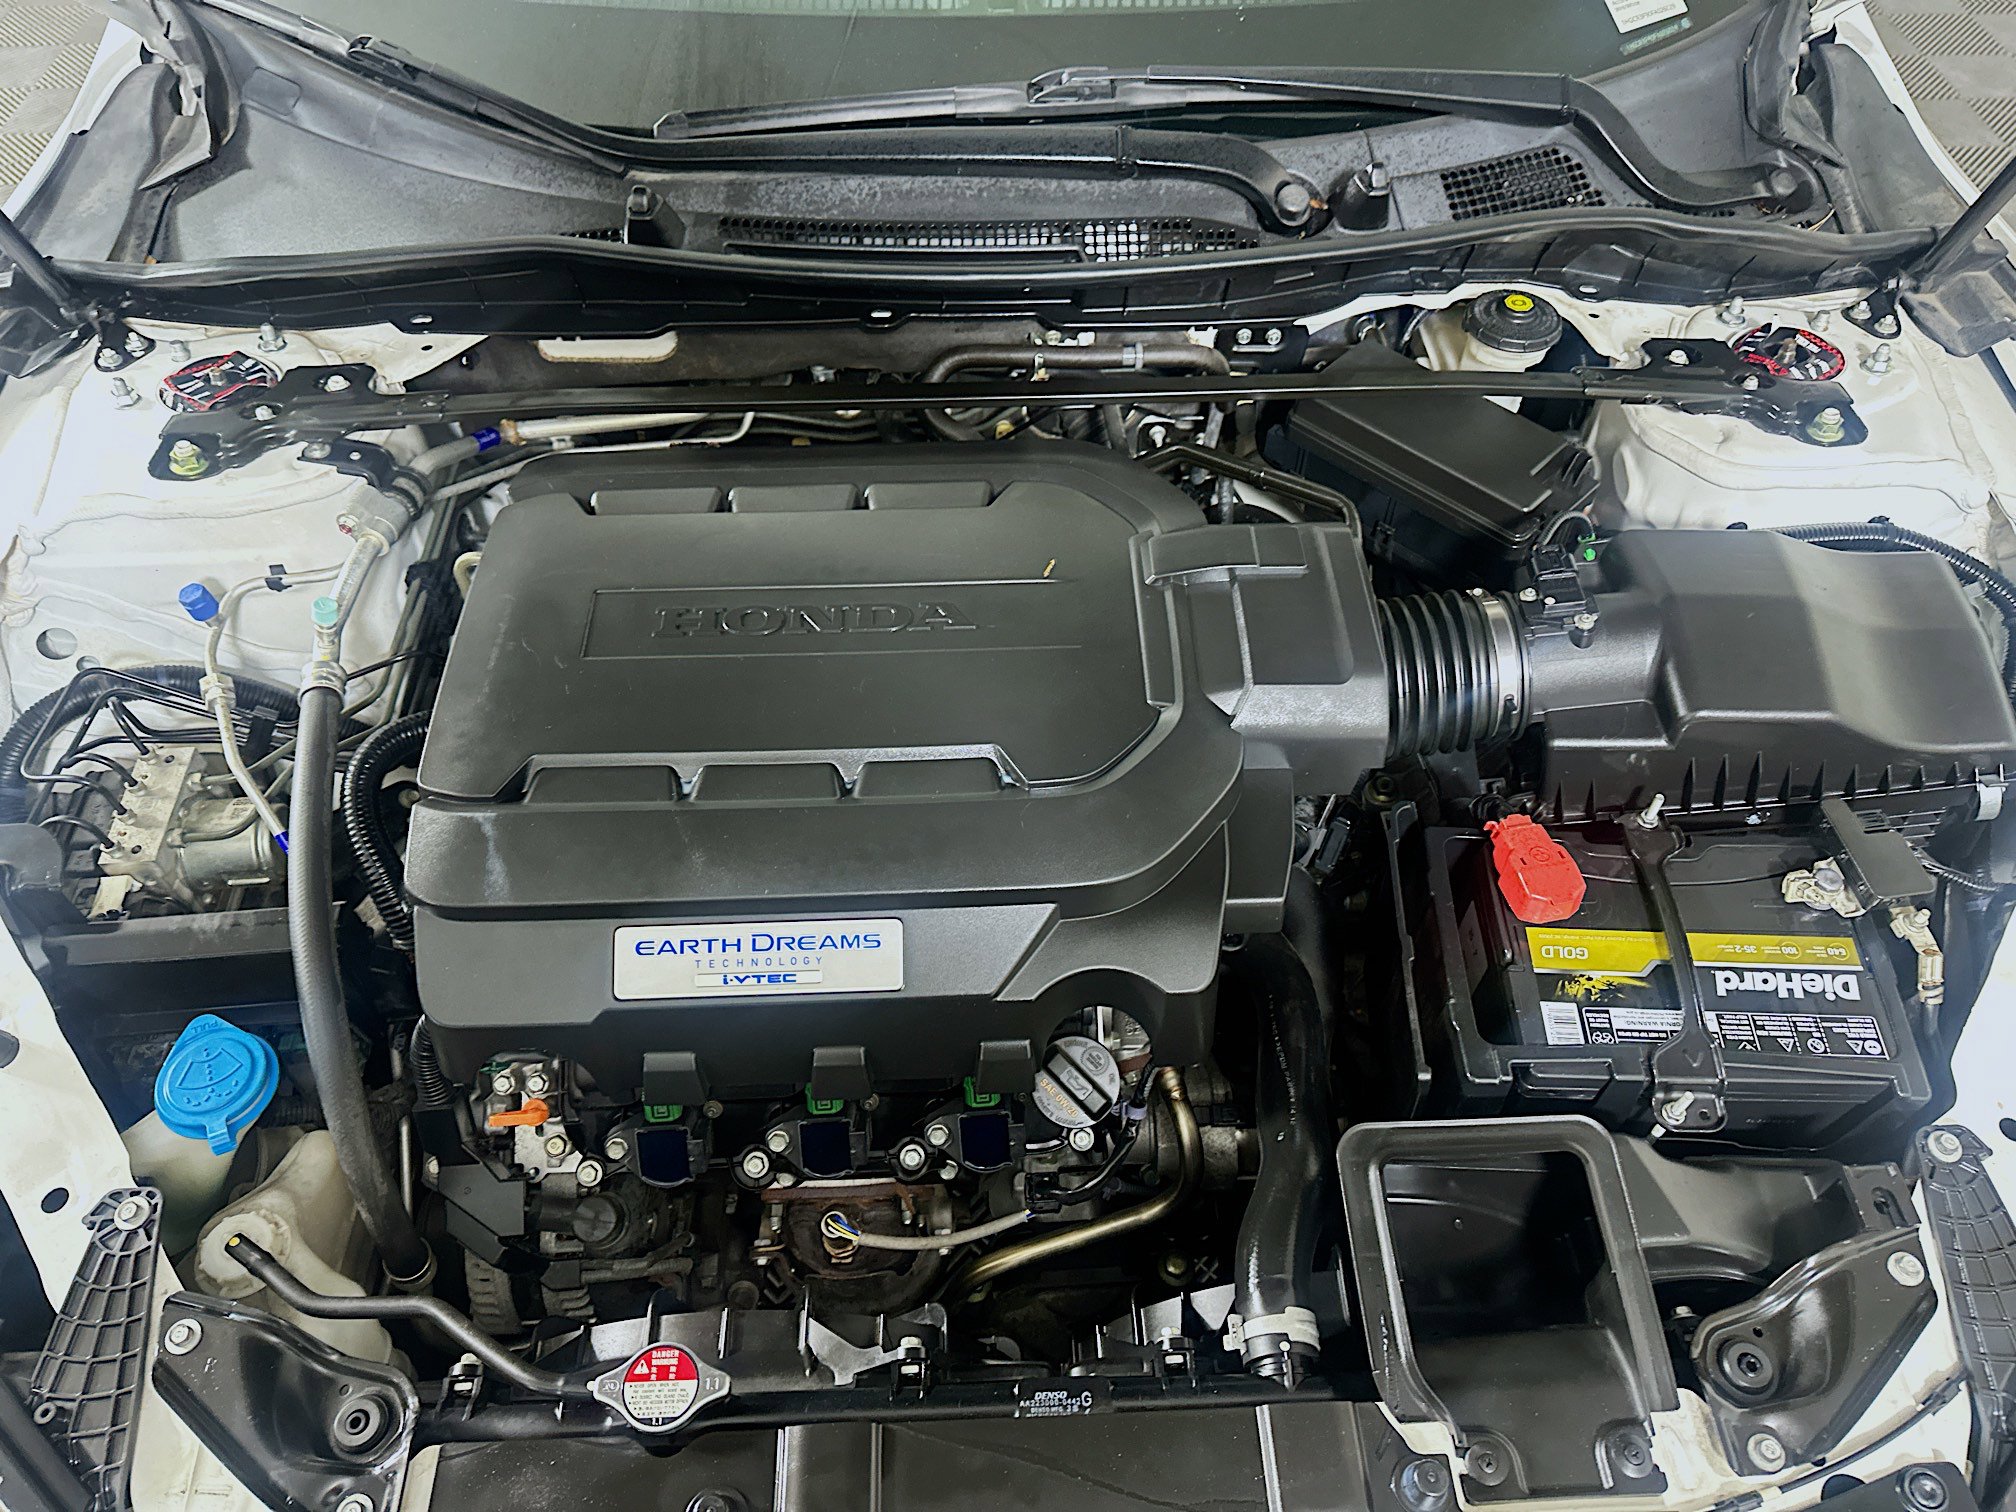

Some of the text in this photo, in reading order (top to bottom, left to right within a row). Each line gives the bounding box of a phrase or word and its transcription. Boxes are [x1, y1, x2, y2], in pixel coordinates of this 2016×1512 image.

[652, 602, 977, 636] HONDA
[635, 934, 882, 956] EARTH DREAMS
[1734, 944, 1758, 954] 35-2
[1781, 946, 1799, 955] 100
[1541, 945, 1590, 960] GOLD
[695, 956, 823, 968] TECHNOLOGY
[191, 1020, 219, 1034] PULL
[1040, 1078, 1056, 1097] SAE
[1055, 1094, 1079, 1118] 0W-20
[705, 1377, 720, 1391] 1.1
[1034, 1391, 1068, 1400] DENSO
[1081, 1390, 1093, 1407] G
